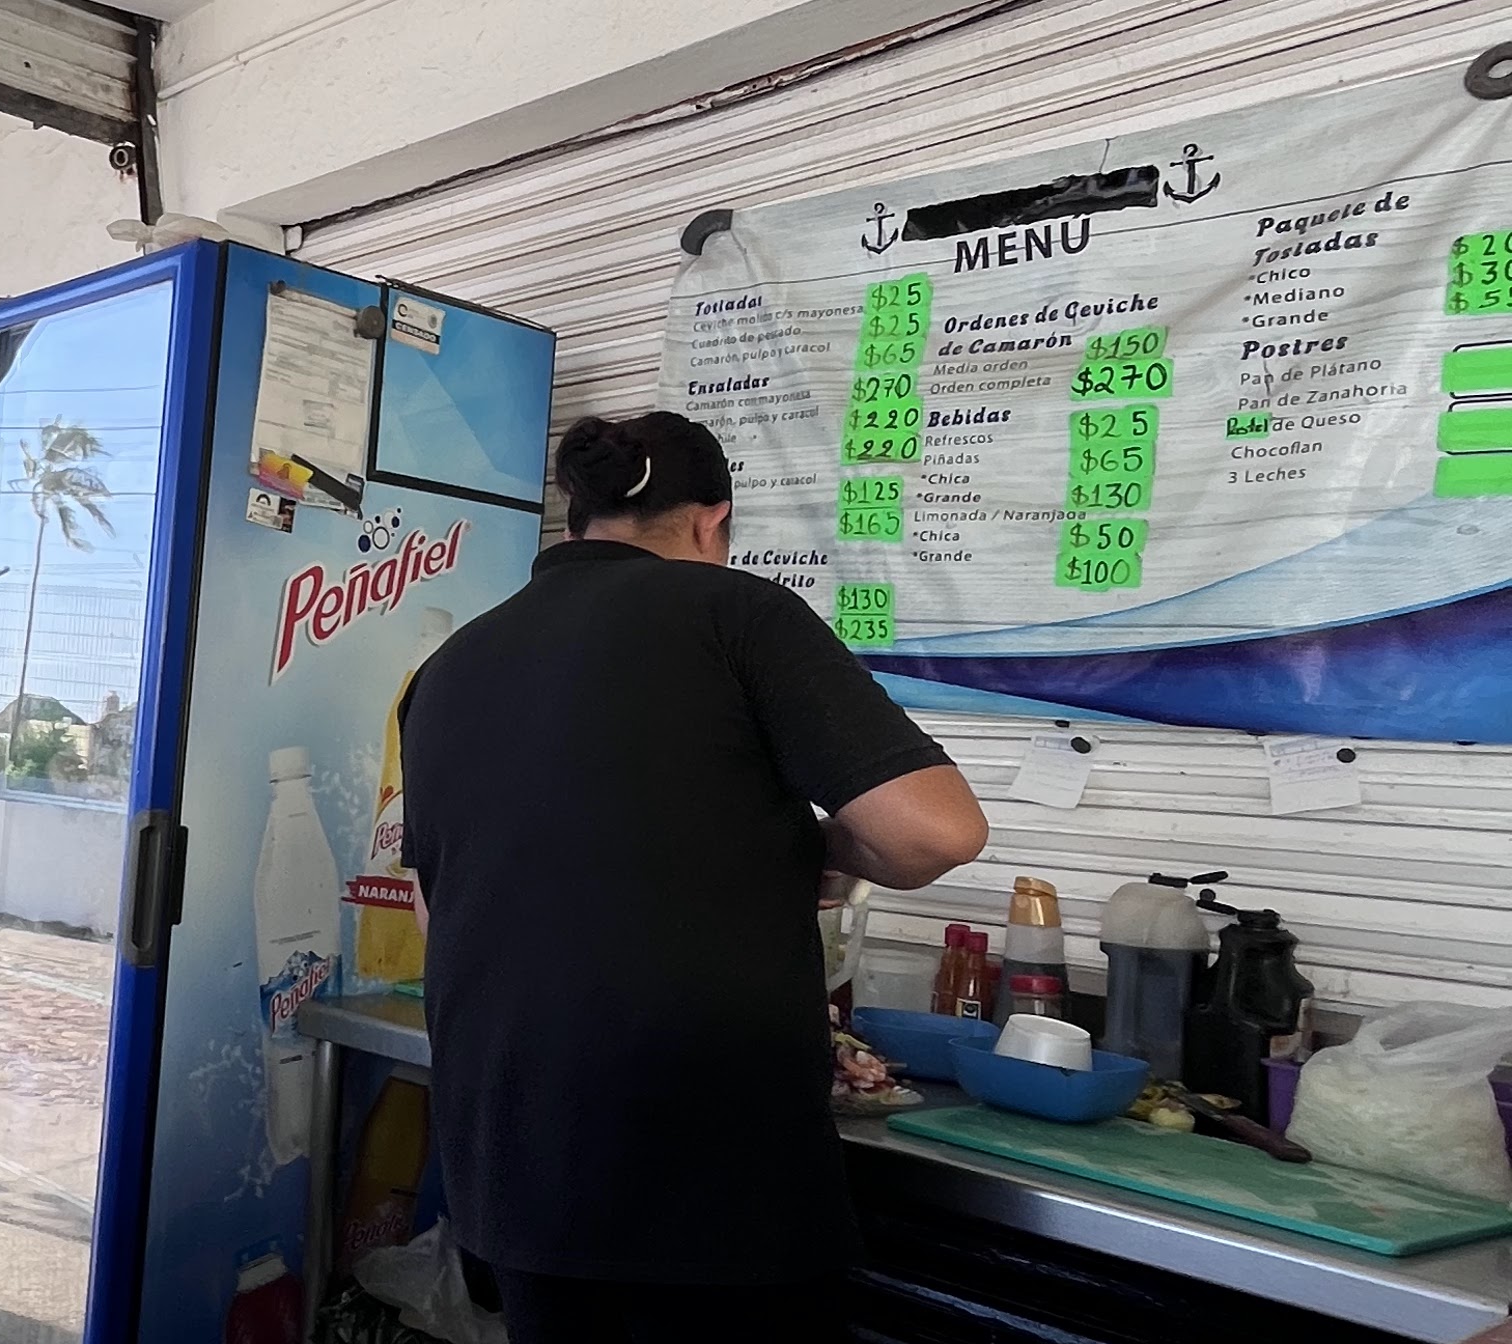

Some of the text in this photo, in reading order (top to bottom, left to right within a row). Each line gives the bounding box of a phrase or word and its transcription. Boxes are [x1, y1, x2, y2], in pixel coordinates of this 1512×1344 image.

[1256, 191, 1410, 237] Paquete de
[1252, 231, 1379, 267] Tostadas
[695, 295, 762, 316] Tostadas
[871, 282, 922, 310] $25
[797, 305, 864, 320] mayonesa
[869, 312, 921, 338] $25
[944, 293, 1159, 335] Ordenes de Ceviche
[739, 332, 755, 343] de
[937, 332, 1073, 357] de Camarón
[1089, 332, 1159, 360] $150
[1240, 336, 1349, 361] Postres
[743, 348, 776, 362] pulpo
[784, 341, 831, 355] caracol
[864, 341, 916, 368] $65
[933, 359, 1029, 376] Media orden
[1071, 362, 1168, 396] $270
[1240, 358, 1382, 386] Pan de Plátano
[688, 374, 770, 396] Ensaladas
[852, 373, 912, 403] $270
[930, 374, 1052, 395] Orden completa
[1238, 383, 1407, 411] Pan de Zanahoria
[685, 398, 735, 412] Camarón
[927, 406, 1012, 428] Bebidas
[849, 407, 919, 431] $220
[1078, 410, 1149, 441] $25
[1272, 412, 1362, 432] de Queso
[924, 432, 994, 447] Refrescos
[1230, 440, 1323, 460] Chocoflan
[923, 452, 980, 467] Piñadas
[1080, 446, 1143, 474] $65
[734, 477, 767, 491] pulpo
[771, 477, 778, 489] y
[1227, 466, 1307, 484] 3 Leches
[842, 480, 900, 506] $125
[1071, 482, 1142, 508] $130
[840, 510, 900, 535] $165
[914, 508, 987, 523] Limonada
[741, 550, 759, 565] de
[763, 549, 828, 566] Ceviche
[1064, 556, 1130, 584] $100
[273, 518, 468, 677] Peñafiel
[838, 585, 888, 611] $130
[835, 617, 888, 641] $235
